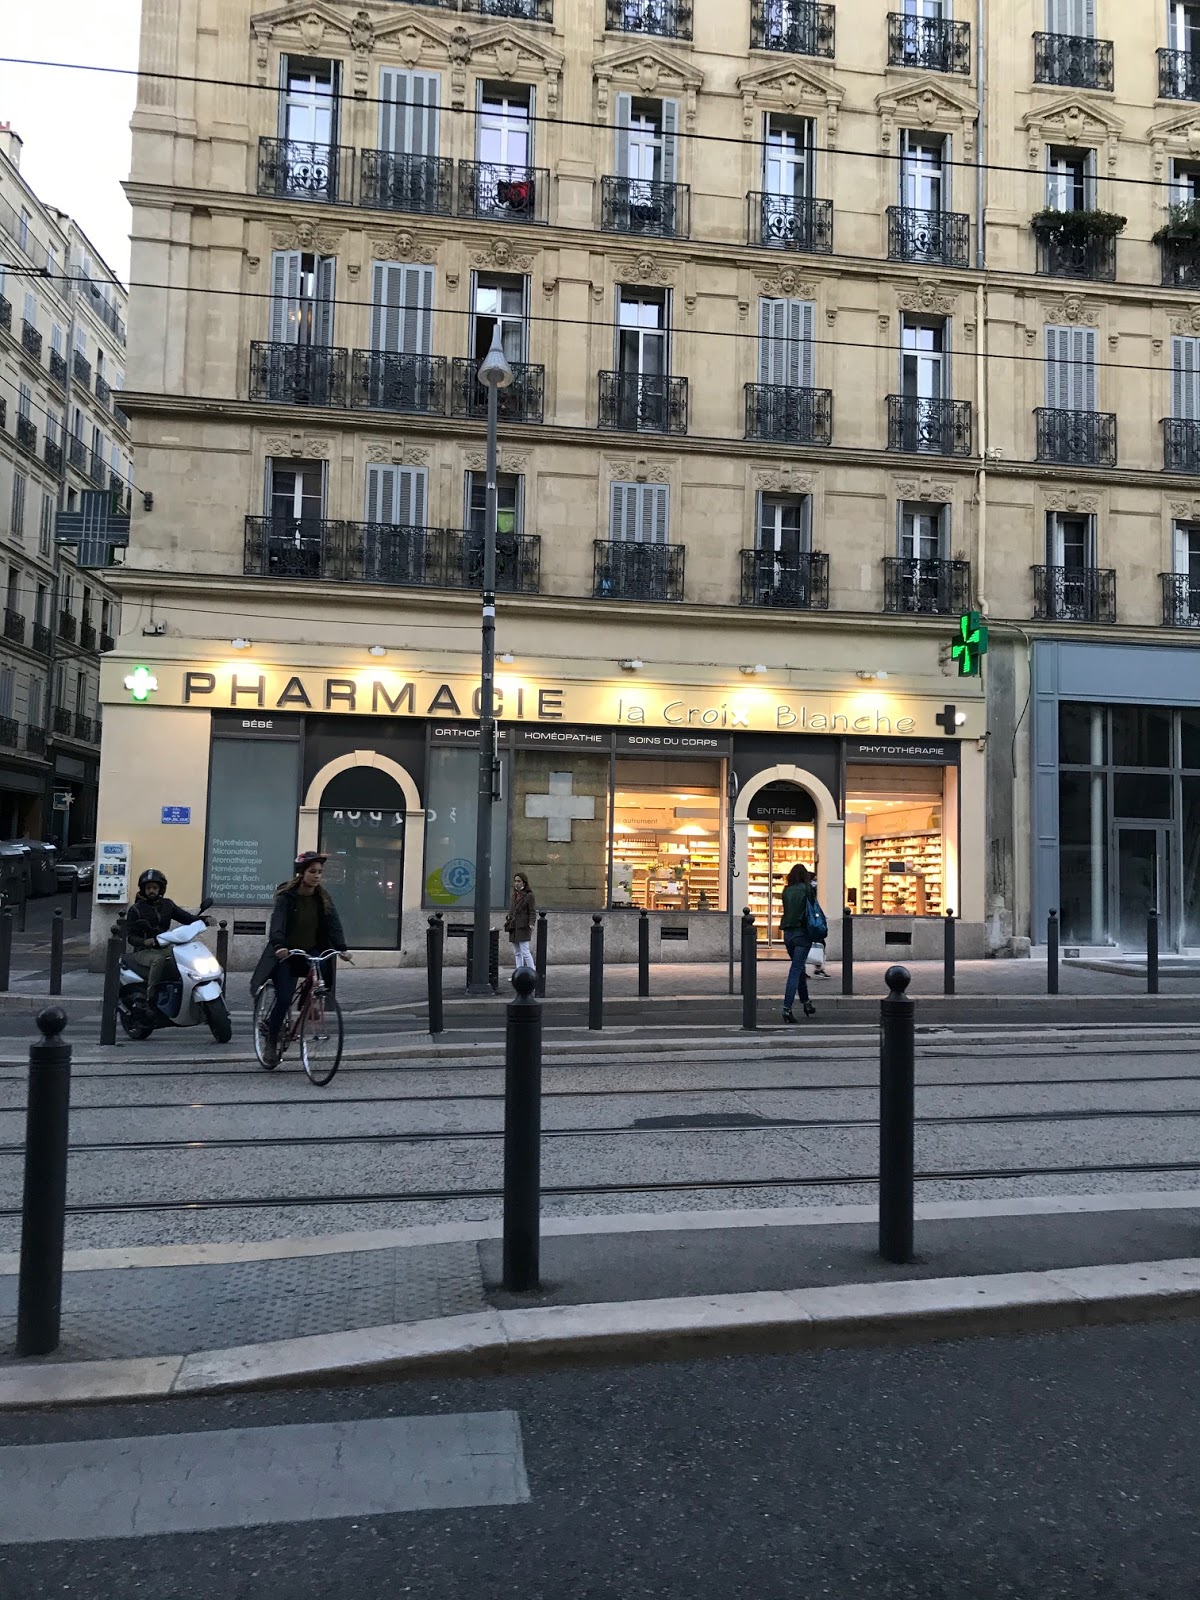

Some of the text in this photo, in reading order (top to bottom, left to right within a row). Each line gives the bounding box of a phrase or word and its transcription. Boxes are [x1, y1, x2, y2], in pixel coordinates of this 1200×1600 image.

[184, 671, 565, 719] PHARMACIE
[618, 698, 916, 734] la Croix Blanche
[242, 720, 274, 729] BÉBÉ
[434, 728, 507, 739] ORTHOPIE
[524, 731, 603, 742] HOMÉOPATHIE
[628, 736, 661, 745] SOINS
[681, 738, 718, 747] CORPS
[859, 745, 944, 755] PHYTOTHÉRAPIE
[757, 807, 796, 815] ENTRÉE
[212, 838, 259, 847] Phytothérapie
[212, 857, 263, 865] Aromathérapie
[211, 865, 257, 873] Homéopathie
[242, 874, 260, 882] Bach
[210, 882, 239, 892] Hygiène
[240, 883, 249, 891] de
[250, 883, 274, 891] beauté
[210, 891, 226, 899] Mon
[227, 891, 245, 899] bébé
